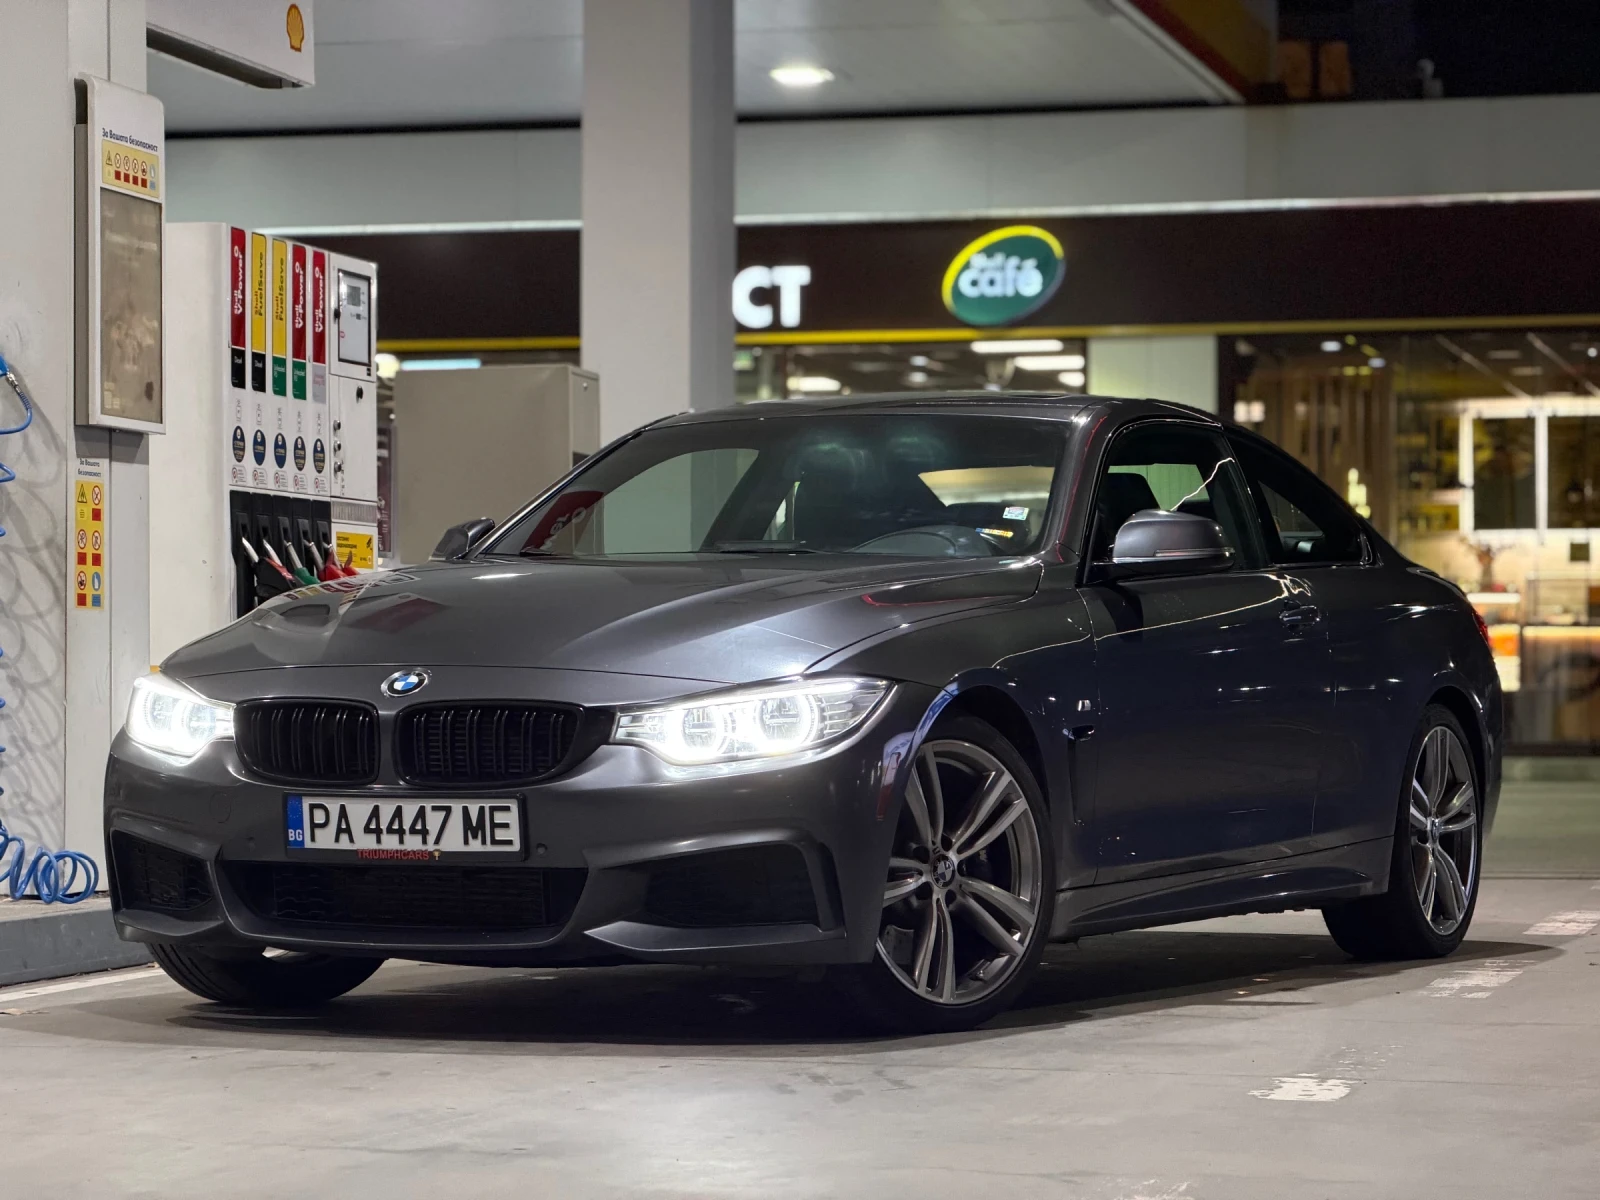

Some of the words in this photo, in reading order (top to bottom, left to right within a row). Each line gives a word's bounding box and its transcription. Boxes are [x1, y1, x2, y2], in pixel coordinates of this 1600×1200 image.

[102, 127, 109, 139] За
[109, 129, 128, 143] Вашата
[128, 135, 158, 152] безопасност
[288, 829, 303, 842] BG
[308, 803, 355, 844] PA
[363, 804, 452, 846] 4447
[461, 805, 514, 846] ME
[357, 848, 429, 861] TRIUMPHCARS
